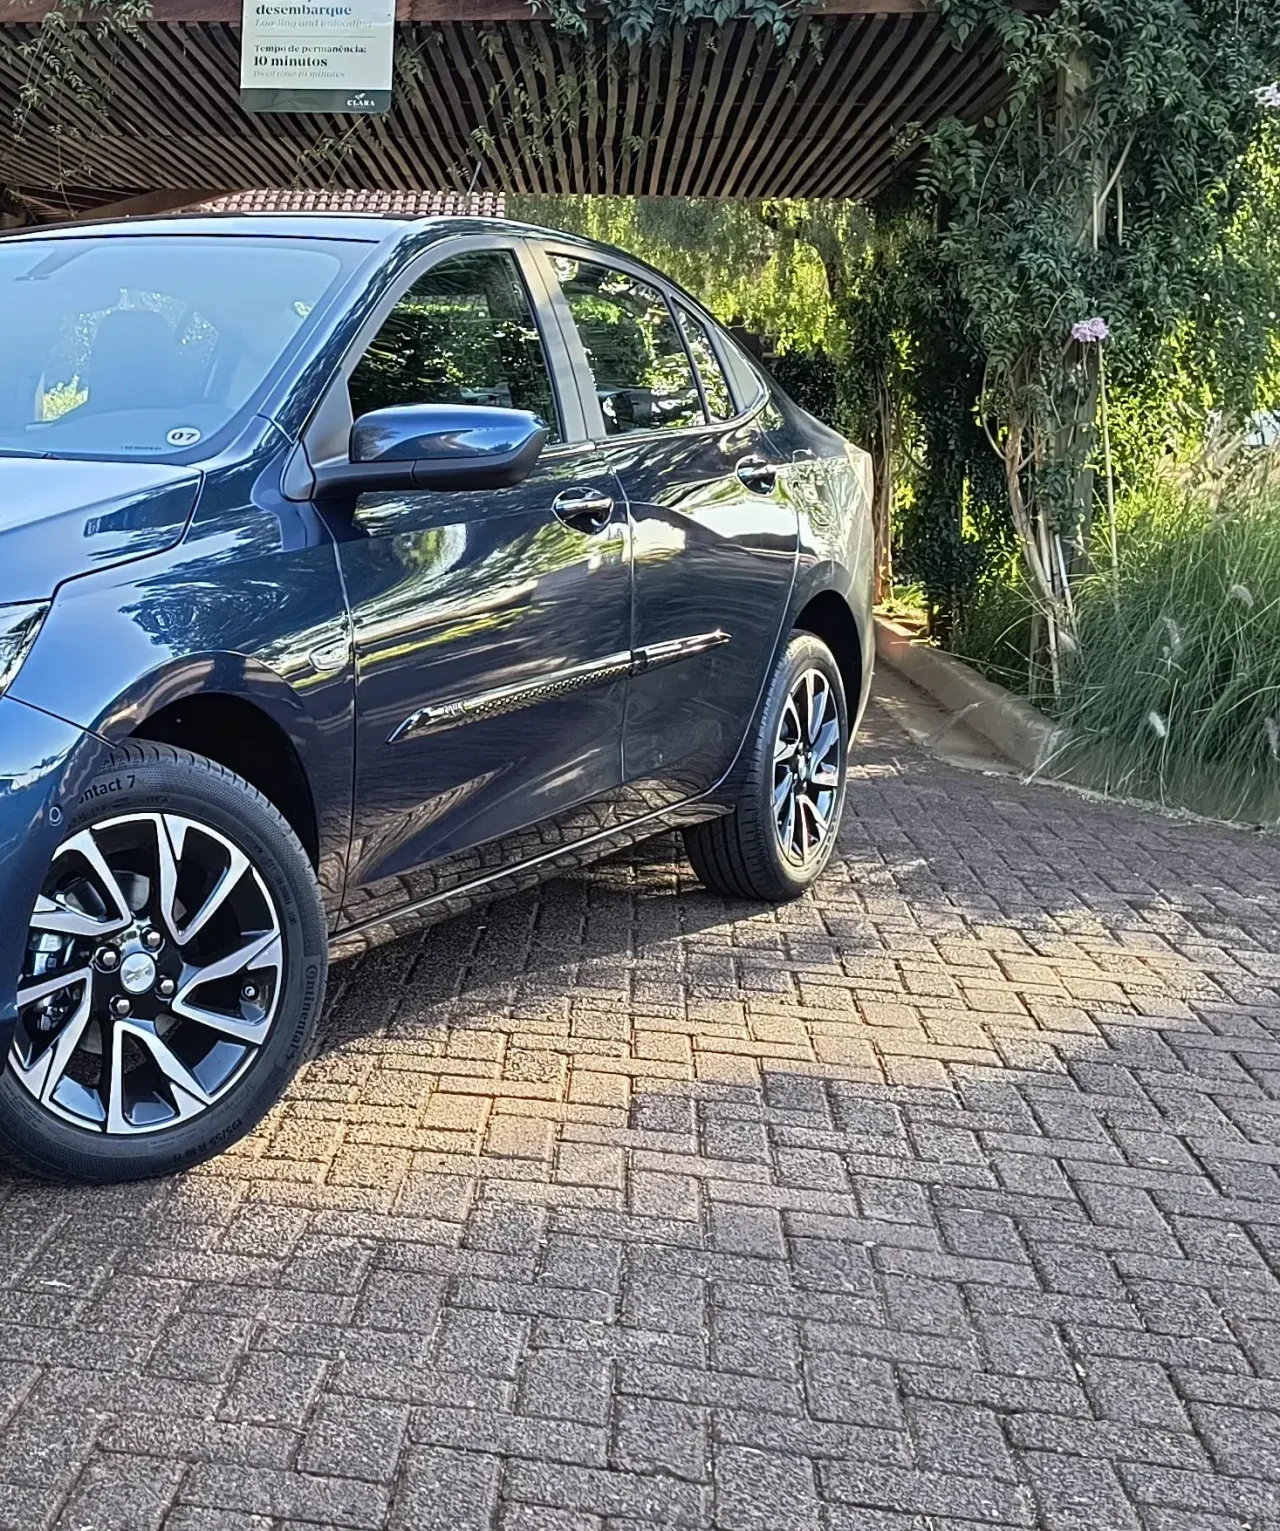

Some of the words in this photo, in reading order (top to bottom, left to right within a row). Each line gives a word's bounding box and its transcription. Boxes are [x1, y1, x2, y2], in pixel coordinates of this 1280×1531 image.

[255, 4, 352, 17] desembarque
[298, 19, 319, 27] and
[253, 44, 286, 54] Tempo
[301, 44, 367, 54] permanência:
[254, 56, 268, 66] 10
[271, 55, 328, 66] minutos
[346, 99, 375, 107] CLARA
[171, 431, 197, 441] 07
[127, 774, 136, 788] 7
